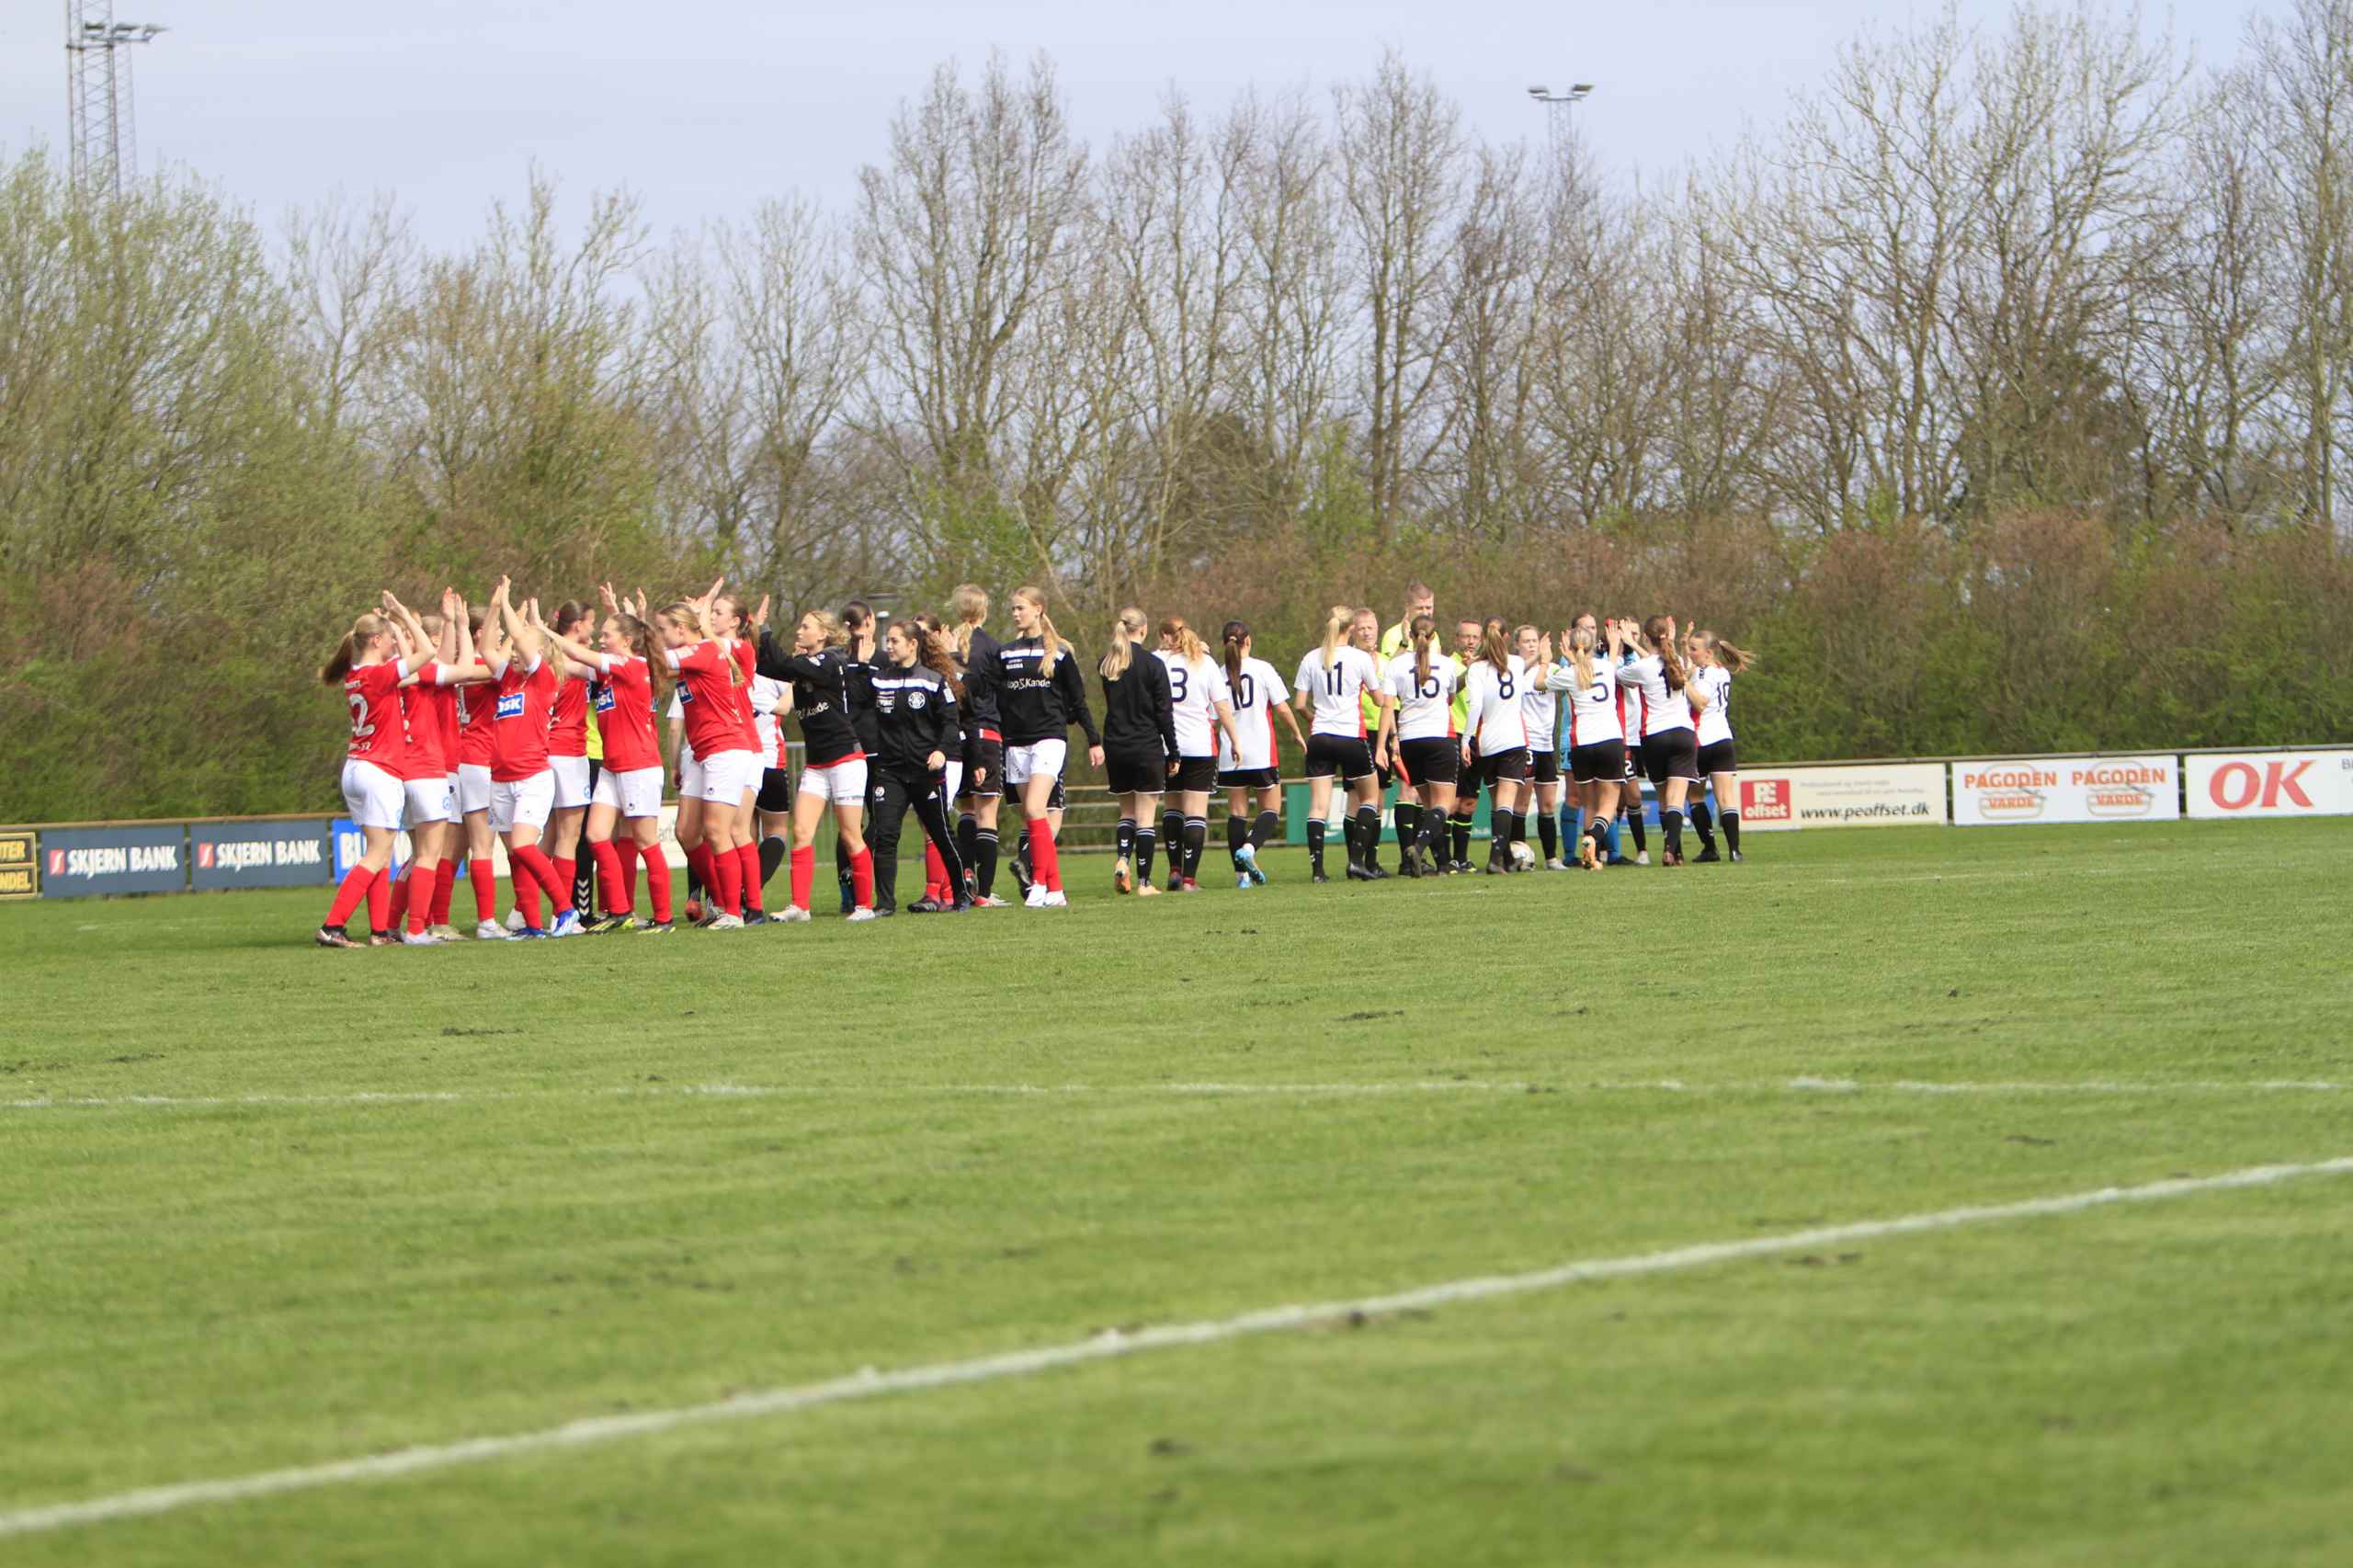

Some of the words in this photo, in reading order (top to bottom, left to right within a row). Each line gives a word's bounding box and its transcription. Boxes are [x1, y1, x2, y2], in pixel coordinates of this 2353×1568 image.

[1323, 661, 1343, 696] 11
[1409, 665, 1440, 699] 15
[1497, 669, 1515, 699] 8
[1591, 671, 1608, 702] 5
[349, 693, 376, 736] 2
[1963, 771, 2057, 789] PAGODEN
[2072, 768, 2165, 786] PAGODEN
[2209, 759, 2317, 810] OK
[1745, 803, 1788, 819] offset
[1801, 801, 1930, 821] www.peoffset.dk
[1988, 795, 2035, 810] VARDE
[2097, 792, 2144, 807] VARDE
[67, 846, 127, 881] SKJERN
[130, 845, 178, 872] BANK
[216, 840, 272, 873] SKJERN
[275, 838, 321, 865] BANK
